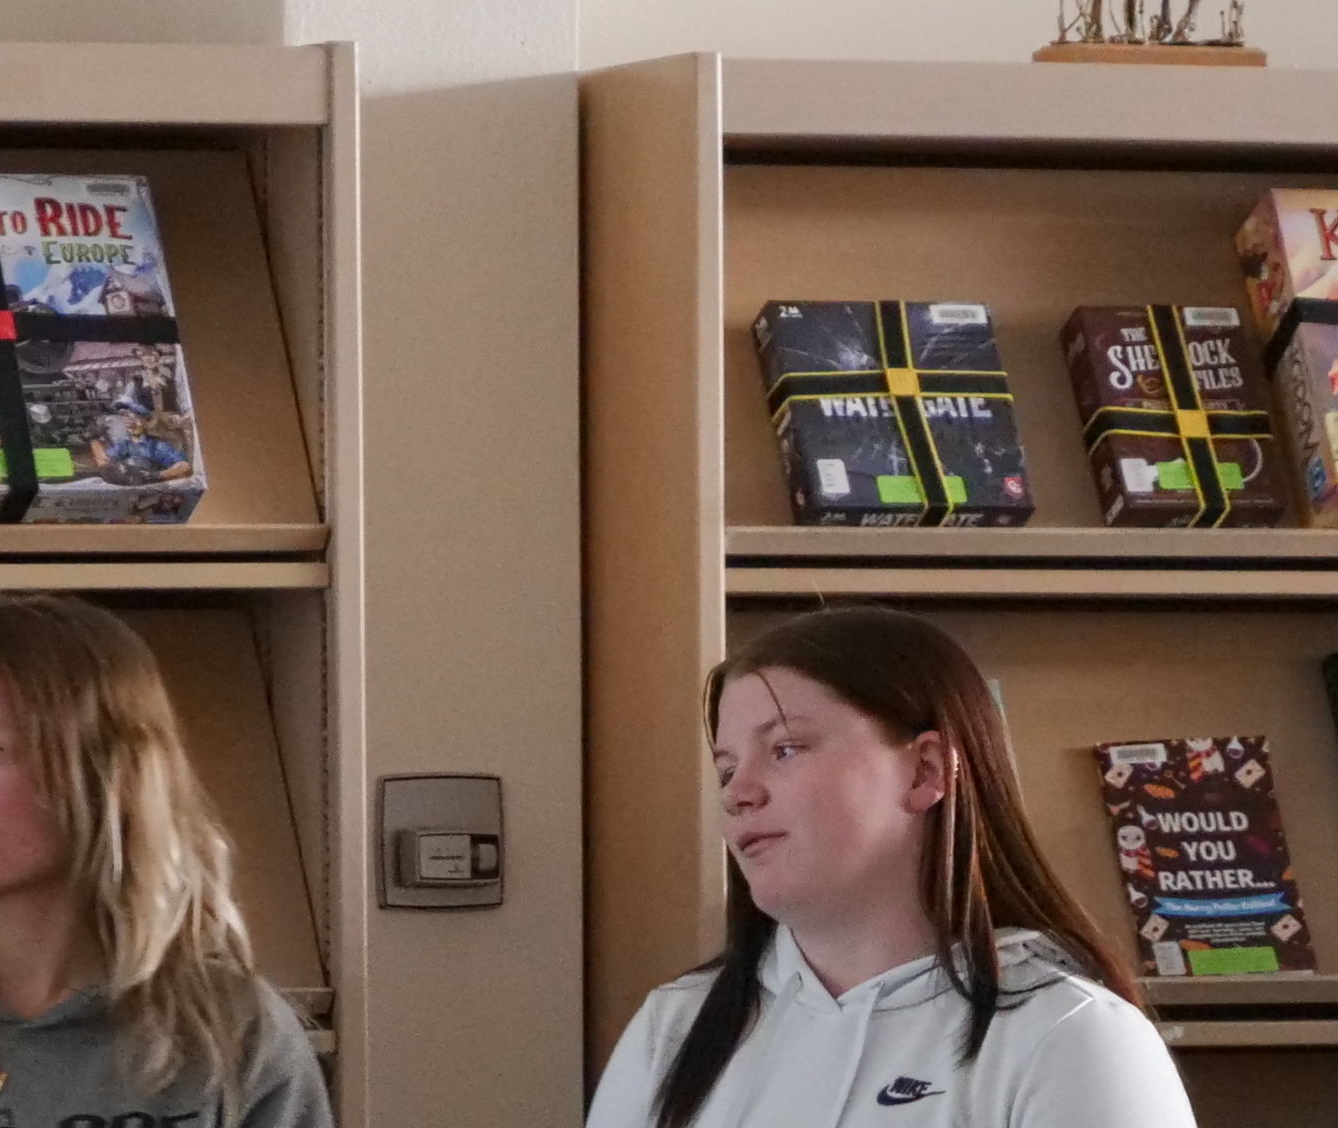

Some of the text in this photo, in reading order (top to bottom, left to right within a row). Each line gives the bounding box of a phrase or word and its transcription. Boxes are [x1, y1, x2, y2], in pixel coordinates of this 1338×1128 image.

[33, 196, 134, 241] RIDE
[41, 239, 136, 267] EUROPE
[1107, 339, 1238, 389] SHEOCK
[1157, 811, 1249, 834] WOULD
[1181, 841, 1237, 863] YOU
[1159, 869, 1277, 892] RATHER...
